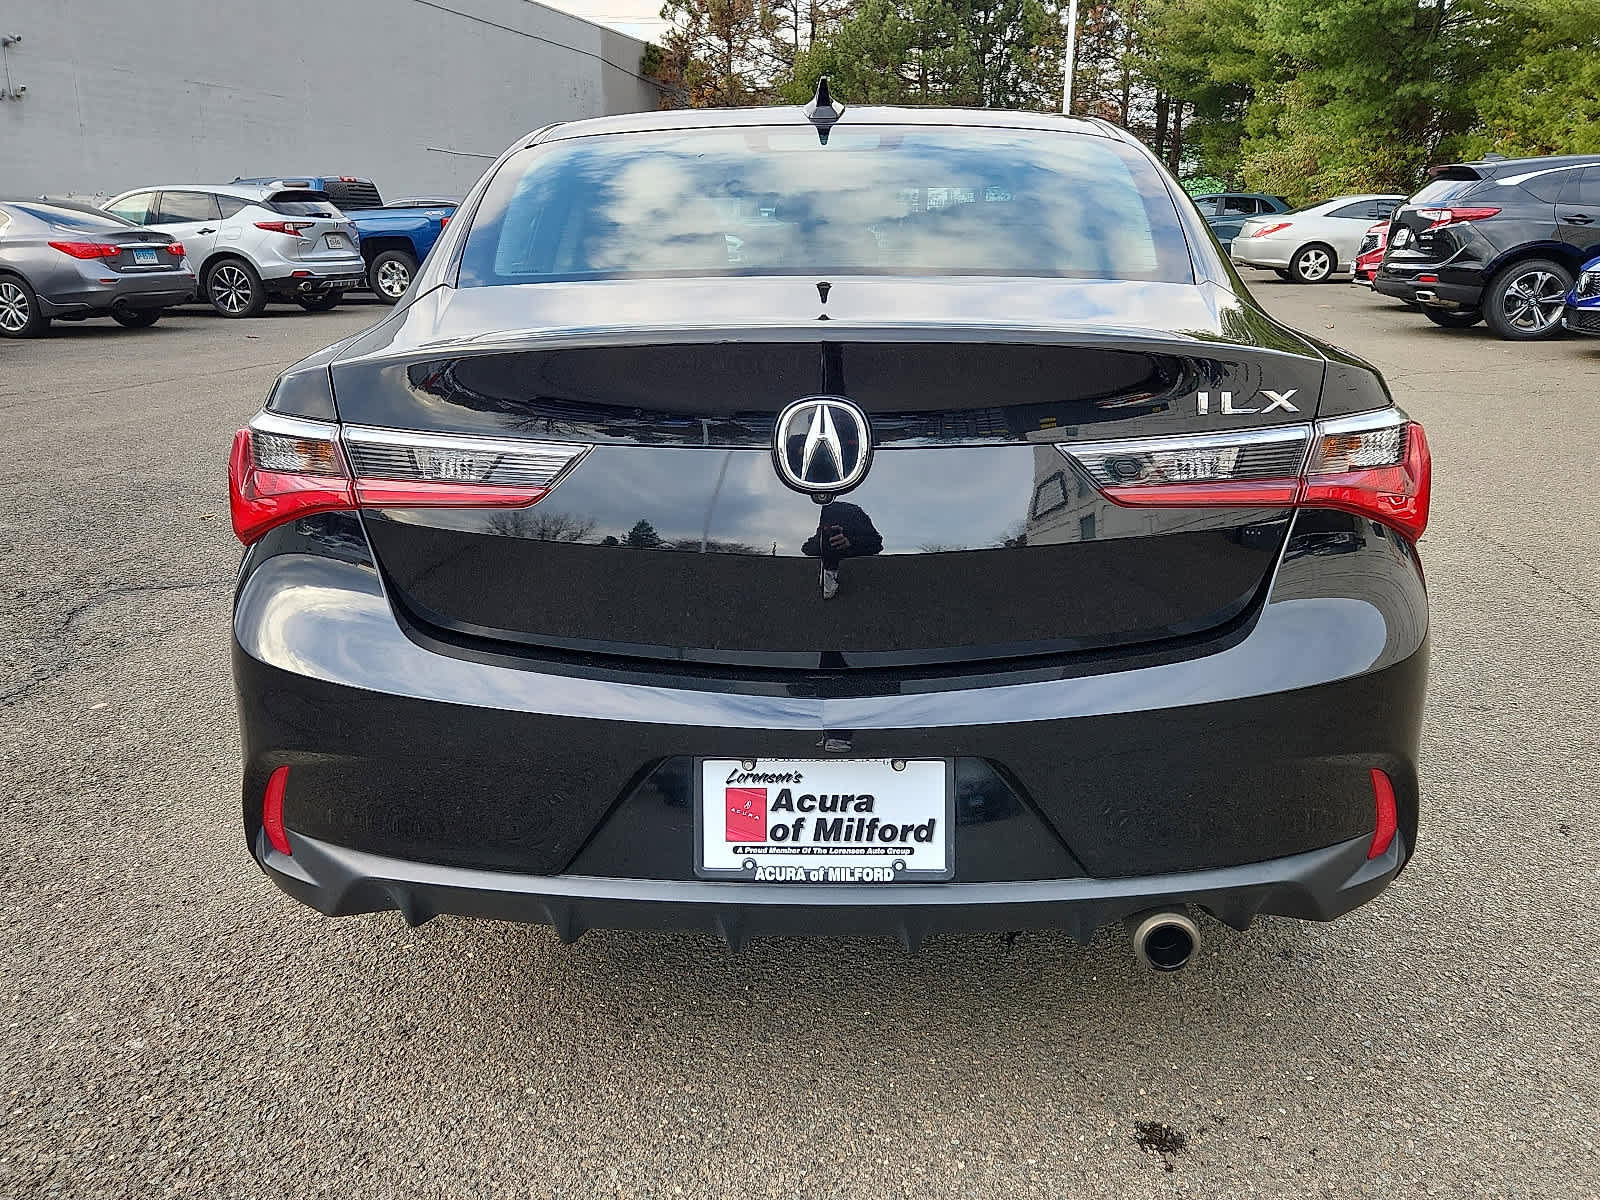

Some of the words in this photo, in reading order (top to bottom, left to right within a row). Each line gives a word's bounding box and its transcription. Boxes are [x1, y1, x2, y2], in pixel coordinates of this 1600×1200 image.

[1197, 389, 1300, 415] ILX
[725, 768, 803, 784] Lorensen's
[770, 788, 875, 813] Acura
[731, 807, 761, 820] ACURA
[769, 817, 806, 843] of
[813, 817, 936, 843] Milford
[736, 846, 744, 854] A
[744, 846, 768, 854] Proud
[828, 847, 866, 855] Lorensen
[866, 847, 885, 855] Auto
[886, 847, 911, 856] Group
[754, 866, 807, 881] ACURA
[809, 867, 825, 882] of
[827, 867, 895, 882] MILFORD
